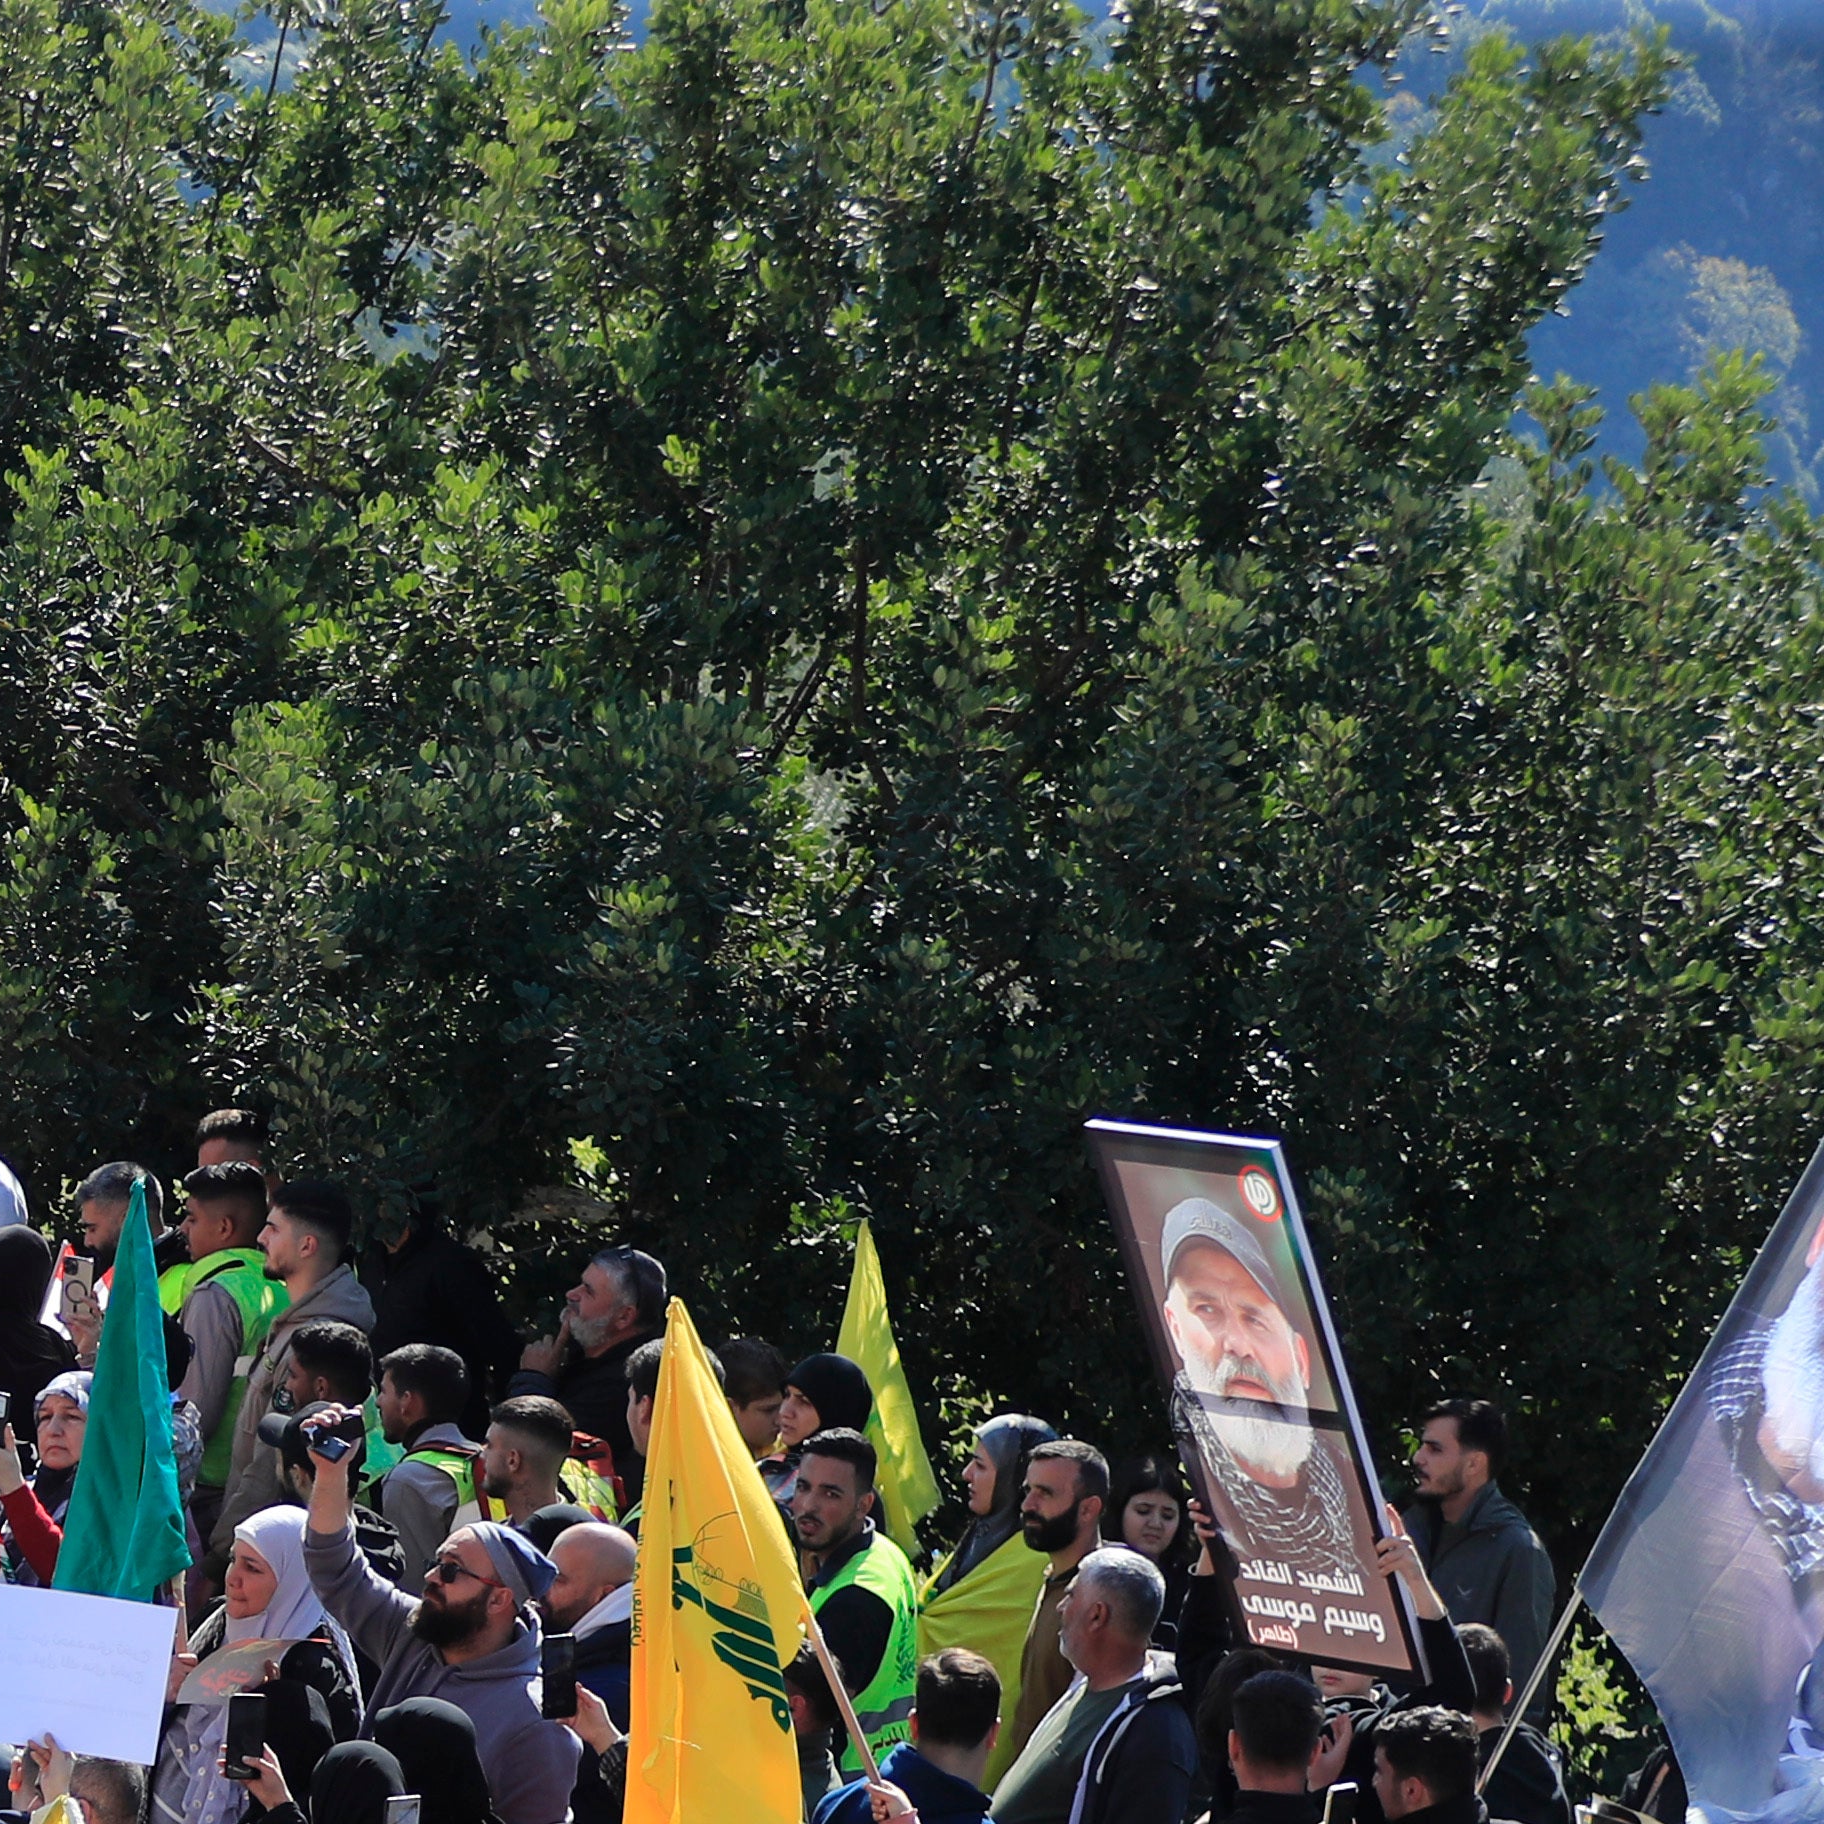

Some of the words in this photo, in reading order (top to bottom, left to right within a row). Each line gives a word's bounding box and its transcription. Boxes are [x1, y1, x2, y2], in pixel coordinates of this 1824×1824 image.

[1239, 1557, 1294, 1586] القائد
[1296, 1564, 1365, 1598] الشهيد
[1241, 1588, 1319, 1624] موسى
[1320, 1603, 1387, 1644] وسيم
